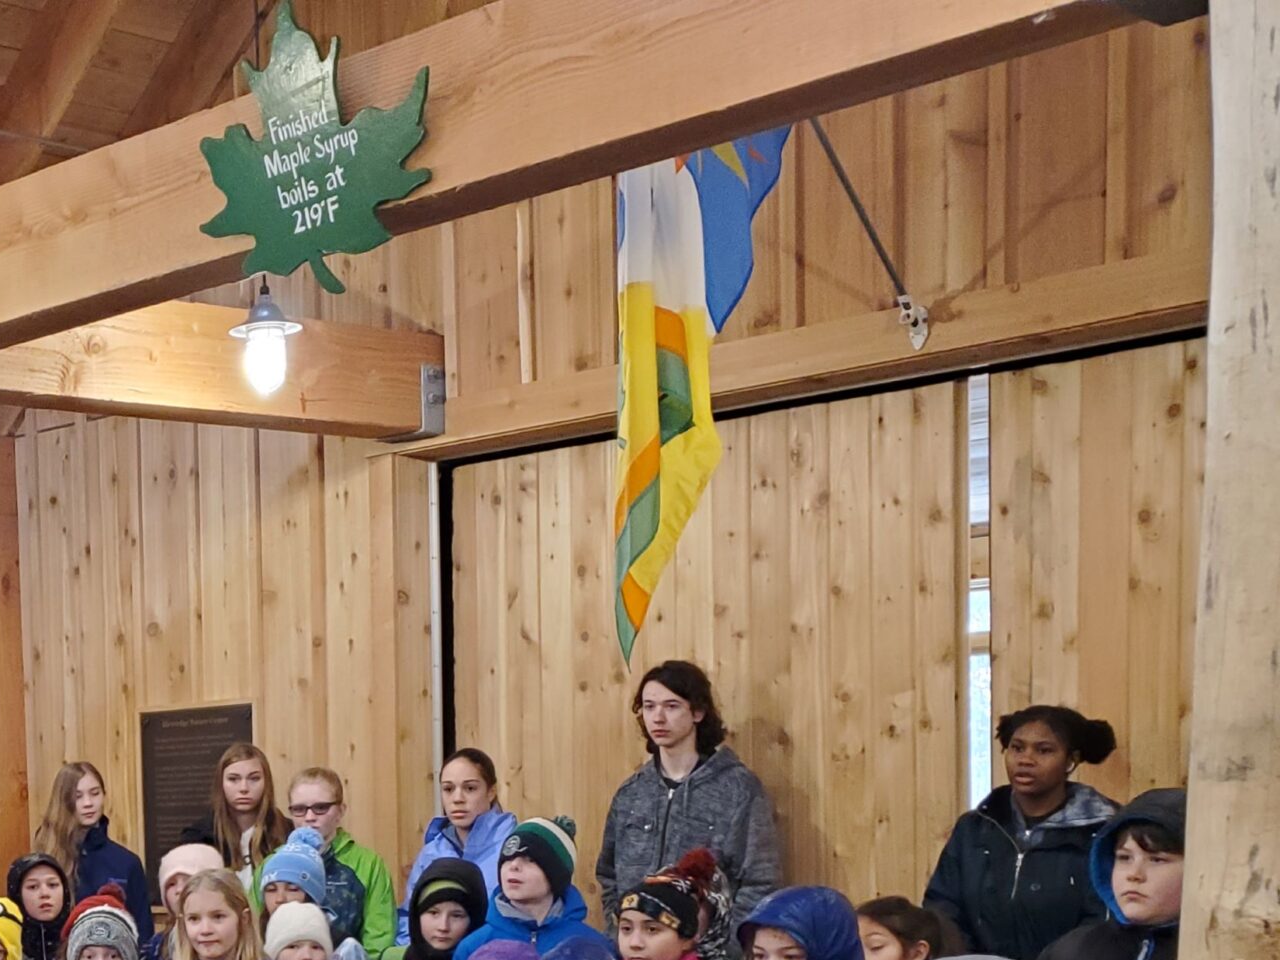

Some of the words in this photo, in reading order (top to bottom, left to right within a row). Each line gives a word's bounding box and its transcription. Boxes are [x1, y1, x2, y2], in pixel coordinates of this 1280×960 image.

[268, 99, 328, 144] Finished
[264, 141, 310, 178] Maple
[314, 128, 358, 164] Syrup
[277, 176, 319, 209] boils
[325, 164, 345, 191] at
